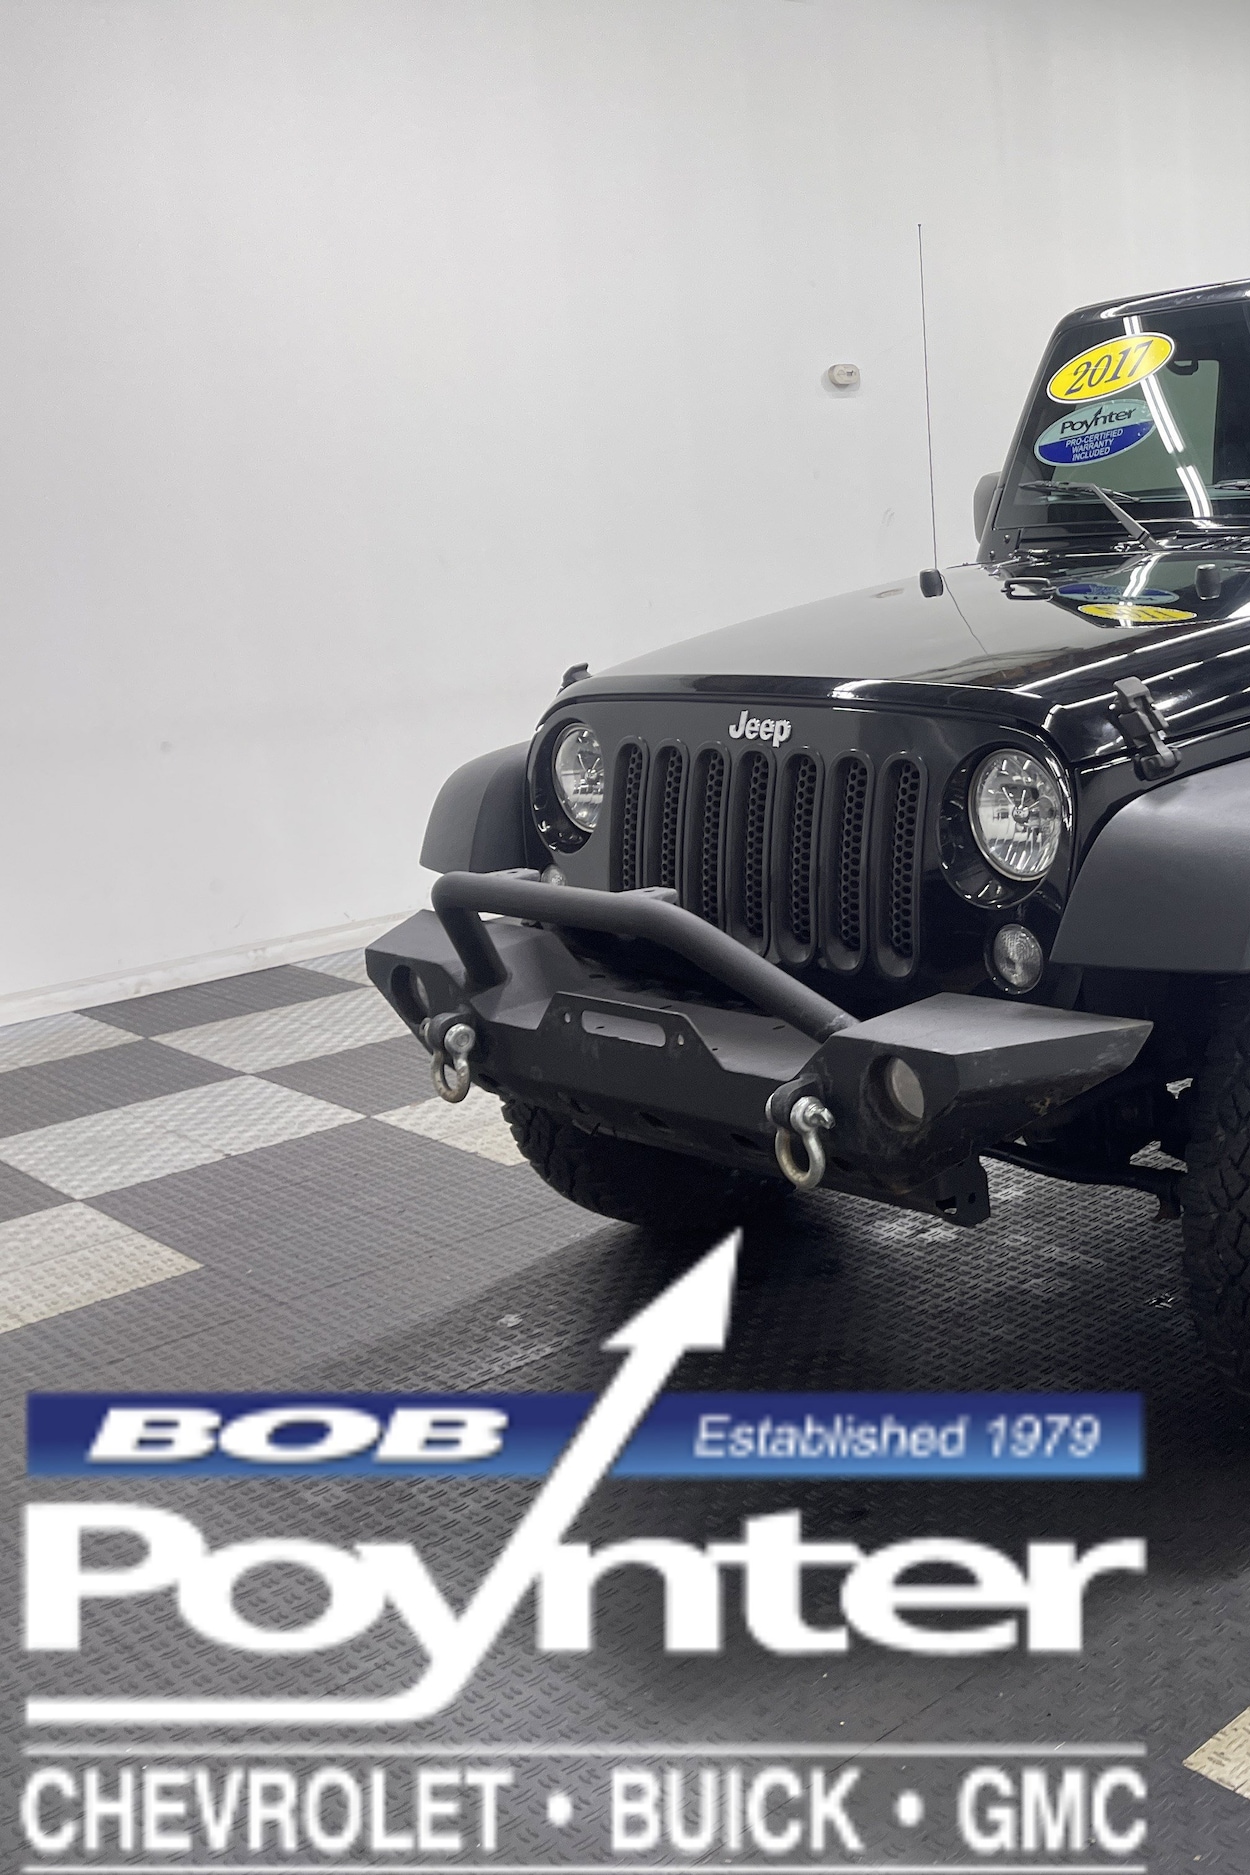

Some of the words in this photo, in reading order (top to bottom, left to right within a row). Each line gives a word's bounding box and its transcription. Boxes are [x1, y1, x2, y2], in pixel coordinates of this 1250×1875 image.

[1064, 339, 1154, 396] 2017
[1061, 406, 1137, 434] Poynter
[1065, 428, 1124, 448] PRO-CERTIFIED
[1072, 438, 1114, 454] WARRANTY
[1072, 446, 1111, 461] INCLUDED
[729, 710, 791, 748] Jeep
